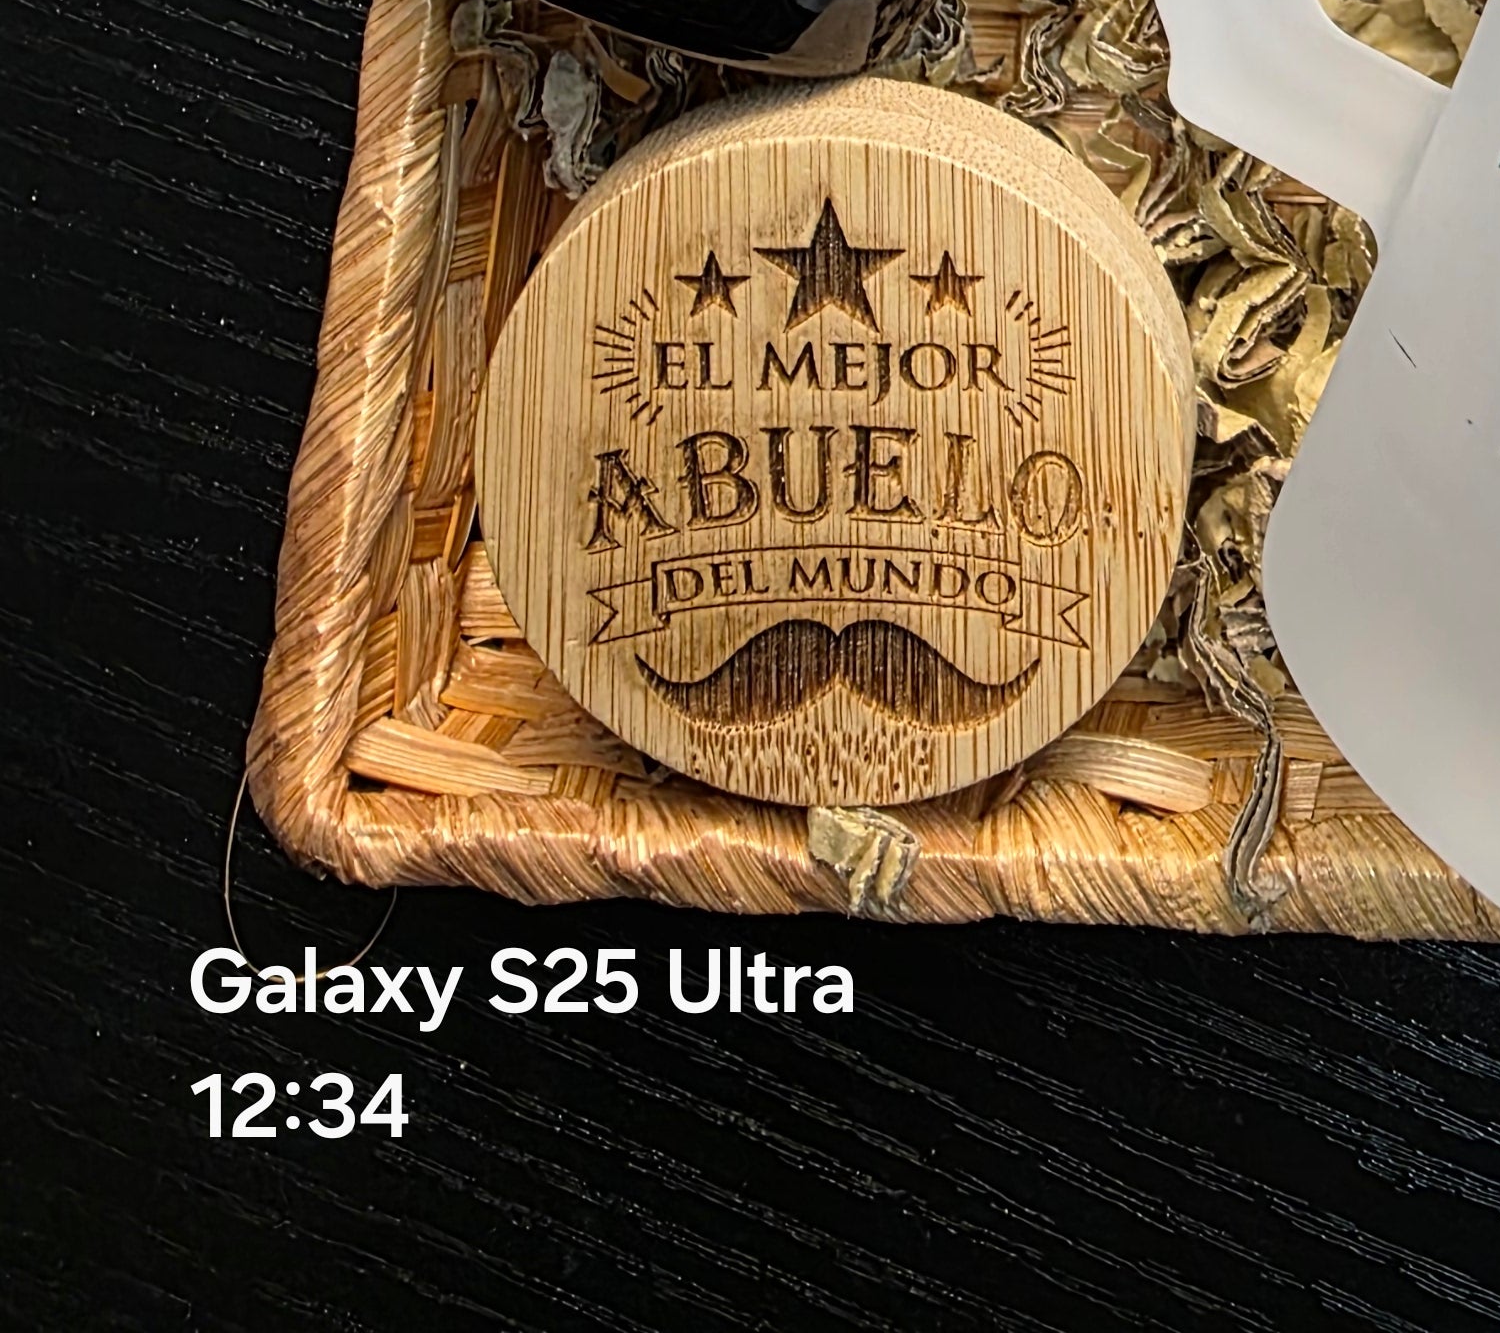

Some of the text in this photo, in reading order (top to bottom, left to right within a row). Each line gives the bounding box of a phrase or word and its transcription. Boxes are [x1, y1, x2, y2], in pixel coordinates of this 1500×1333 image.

[653, 341, 1016, 405] EL MEJOR
[585, 425, 1083, 554] ABUELO
[663, 557, 1016, 605] DEL MUNDO
